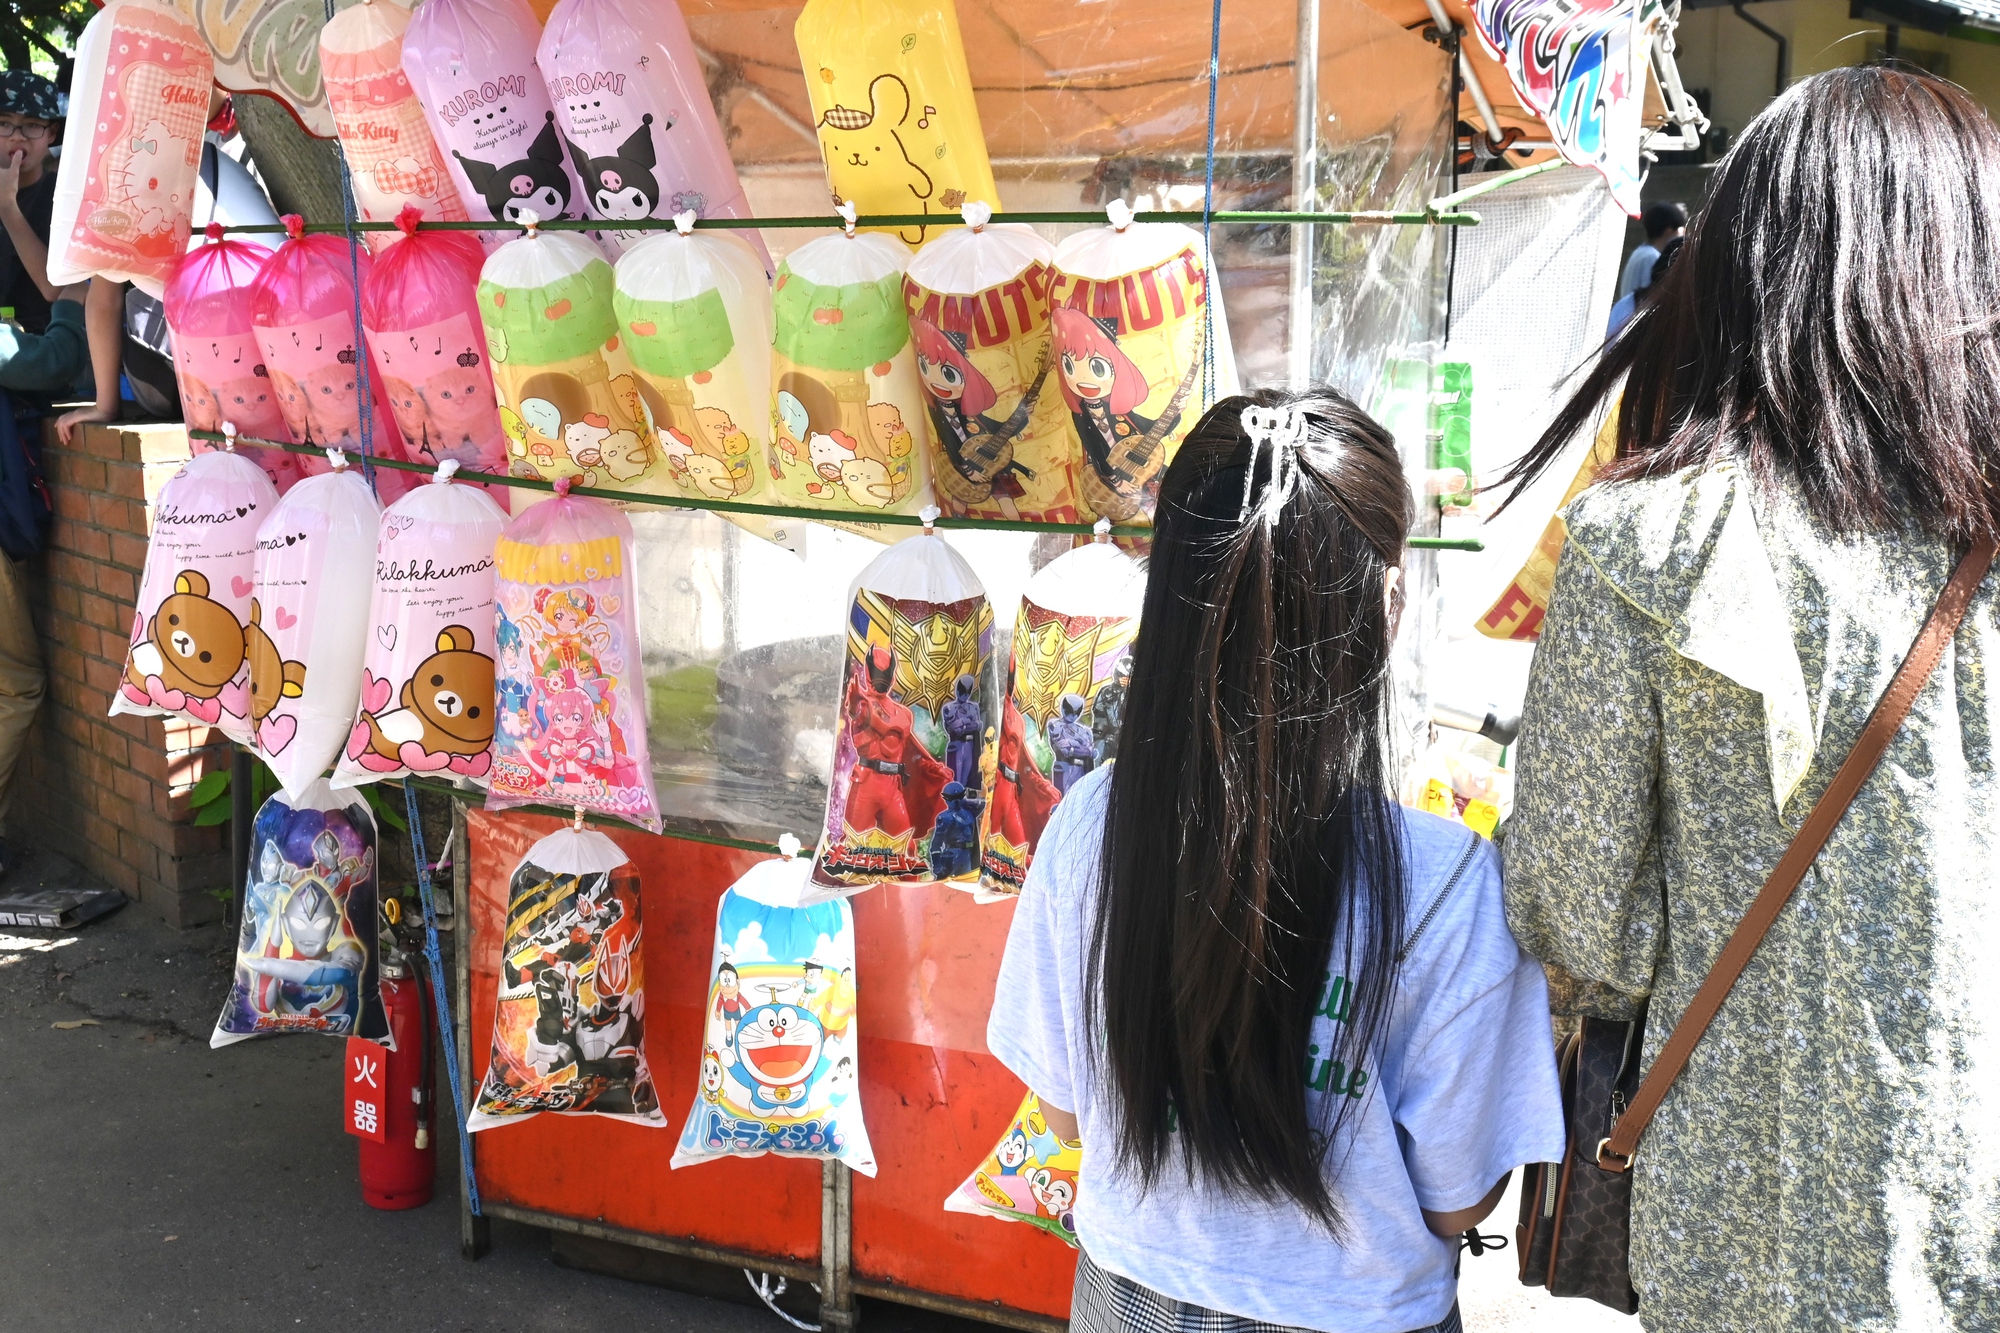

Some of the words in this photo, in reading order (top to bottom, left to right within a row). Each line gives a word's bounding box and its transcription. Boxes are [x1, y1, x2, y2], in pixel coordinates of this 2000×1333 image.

[161, 84, 198, 105] Hello
[439, 74, 526, 127] KUROMI
[475, 122, 506, 138] Kuromi
[506, 118, 515, 127] is
[571, 114, 599, 125] Kuromi
[600, 113, 607, 121] is
[601, 118, 622, 134] style!
[357, 121, 399, 143] Kitty
[473, 137, 499, 151] always
[499, 133, 509, 141] in
[509, 120, 529, 137] style!
[900, 264, 1050, 350] EANUTS
[376, 558, 495, 584] Rilakkuma
[703, 1111, 847, 1153] ドラえもん
